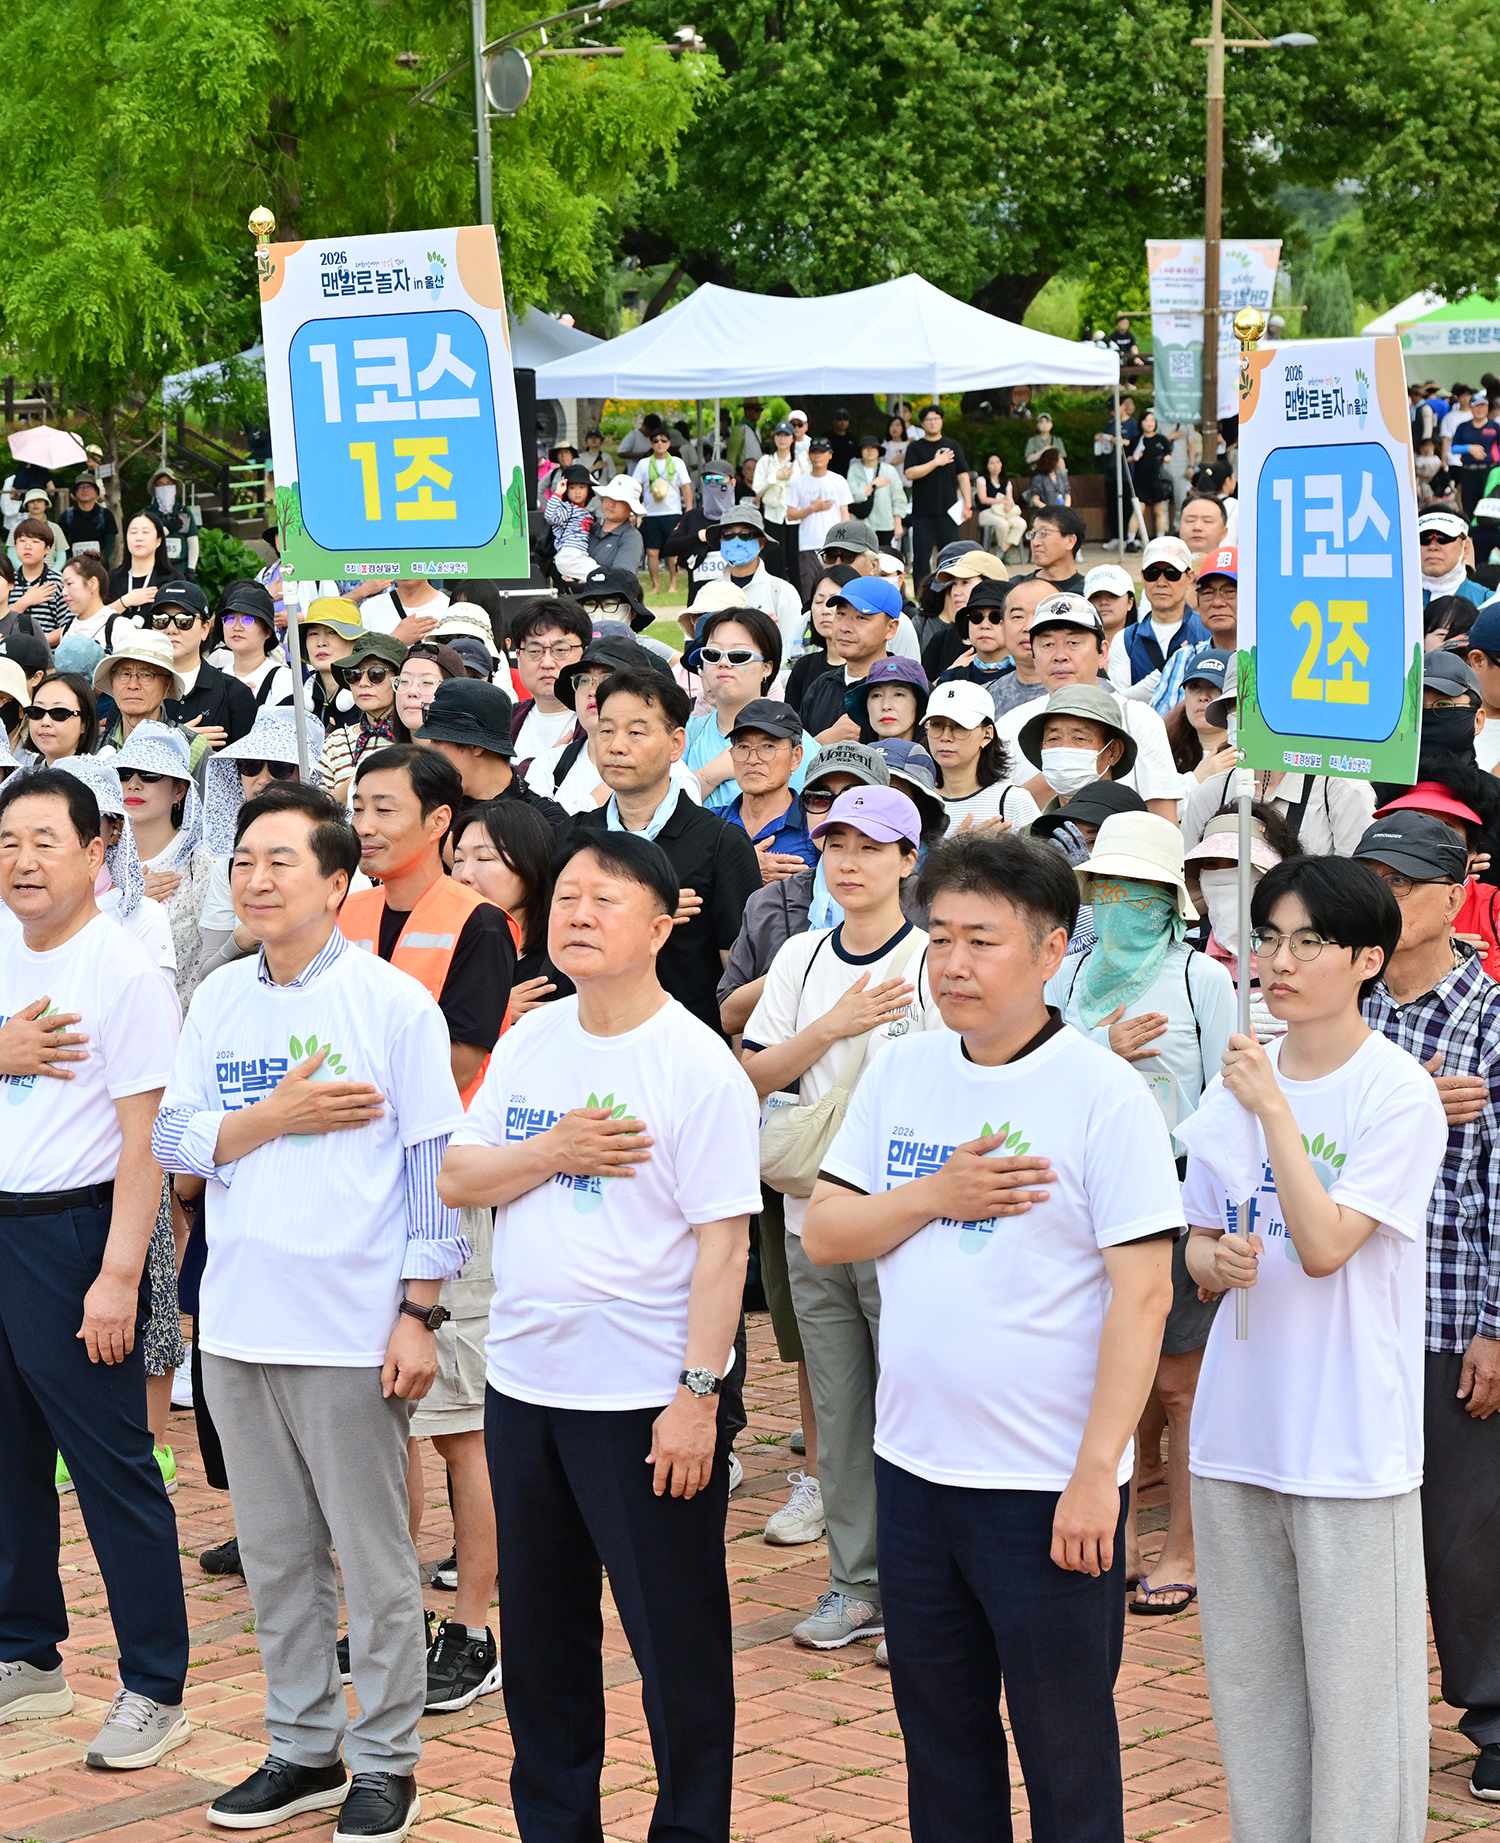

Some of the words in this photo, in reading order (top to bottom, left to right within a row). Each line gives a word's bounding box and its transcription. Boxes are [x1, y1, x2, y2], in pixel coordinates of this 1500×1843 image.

[320, 251, 347, 266] 2026
[321, 265, 374, 298] 맨발로
[376, 267, 411, 295] 놀자
[413, 277, 423, 290] in
[424, 275, 444, 290] 울산
[309, 333, 480, 423] 1코스
[1285, 365, 1303, 381] 2026
[1285, 384, 1320, 421] 맨발로
[1321, 387, 1345, 419] 놀자
[1347, 400, 1354, 415] in
[1354, 398, 1368, 415] 울산
[349, 437, 457, 521] 1조
[1273, 470, 1393, 578] 1코스
[1290, 600, 1370, 705] 2조
[817, 749, 872, 770] Moment
[216, 1051, 234, 1060] 2026
[510, 1095, 526, 1103] 2026
[893, 1126, 915, 1138] 2026
